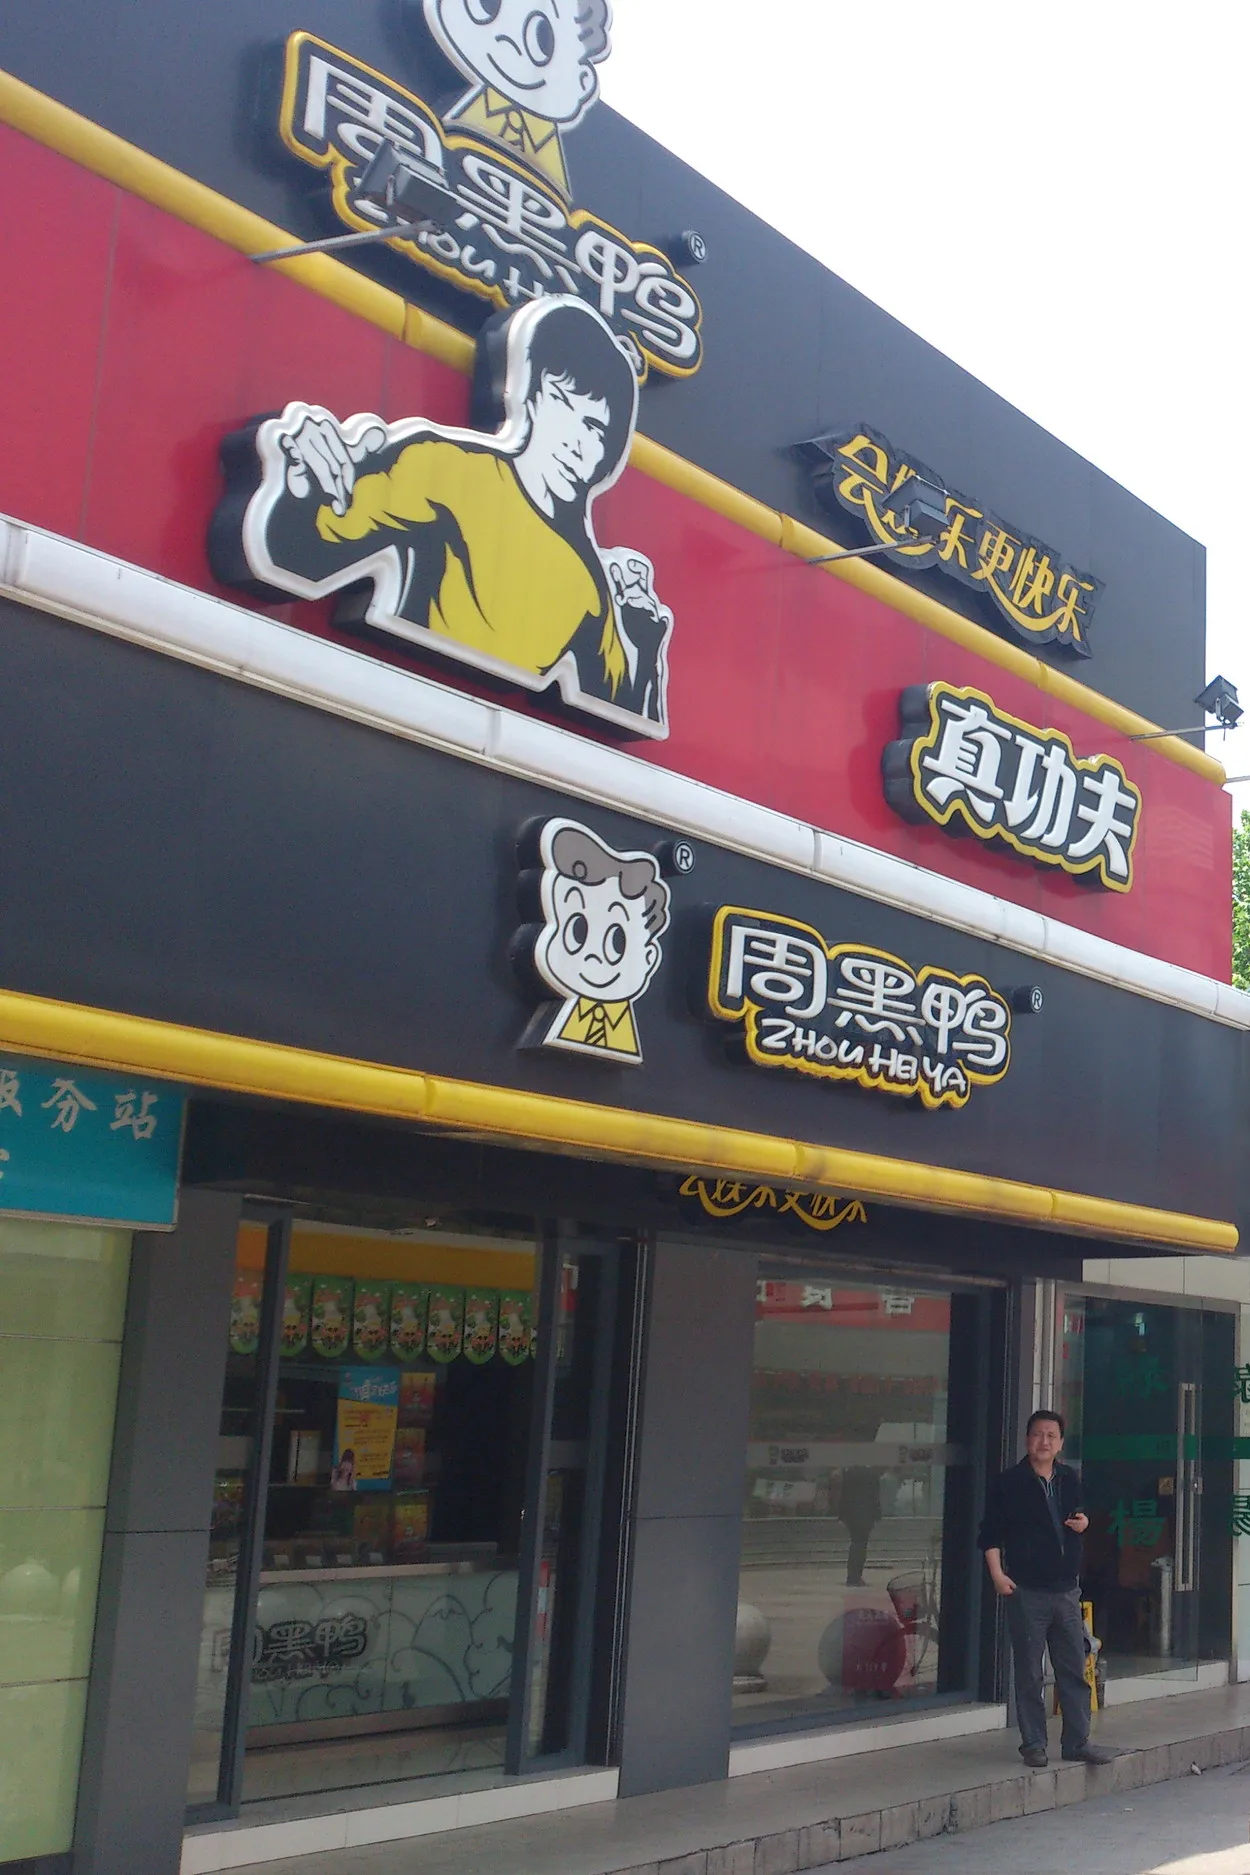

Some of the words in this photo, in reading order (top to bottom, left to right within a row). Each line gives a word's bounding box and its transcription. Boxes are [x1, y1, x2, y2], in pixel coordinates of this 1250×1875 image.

[302, 54, 697, 361] 周黑鸭
[836, 434, 1095, 642] 会乐更快乐
[921, 698, 1138, 878] 真功夫
[725, 925, 1008, 1067] 周黑鸭
[760, 1018, 865, 1069] ZHOU
[920, 1055, 968, 1095] YA
